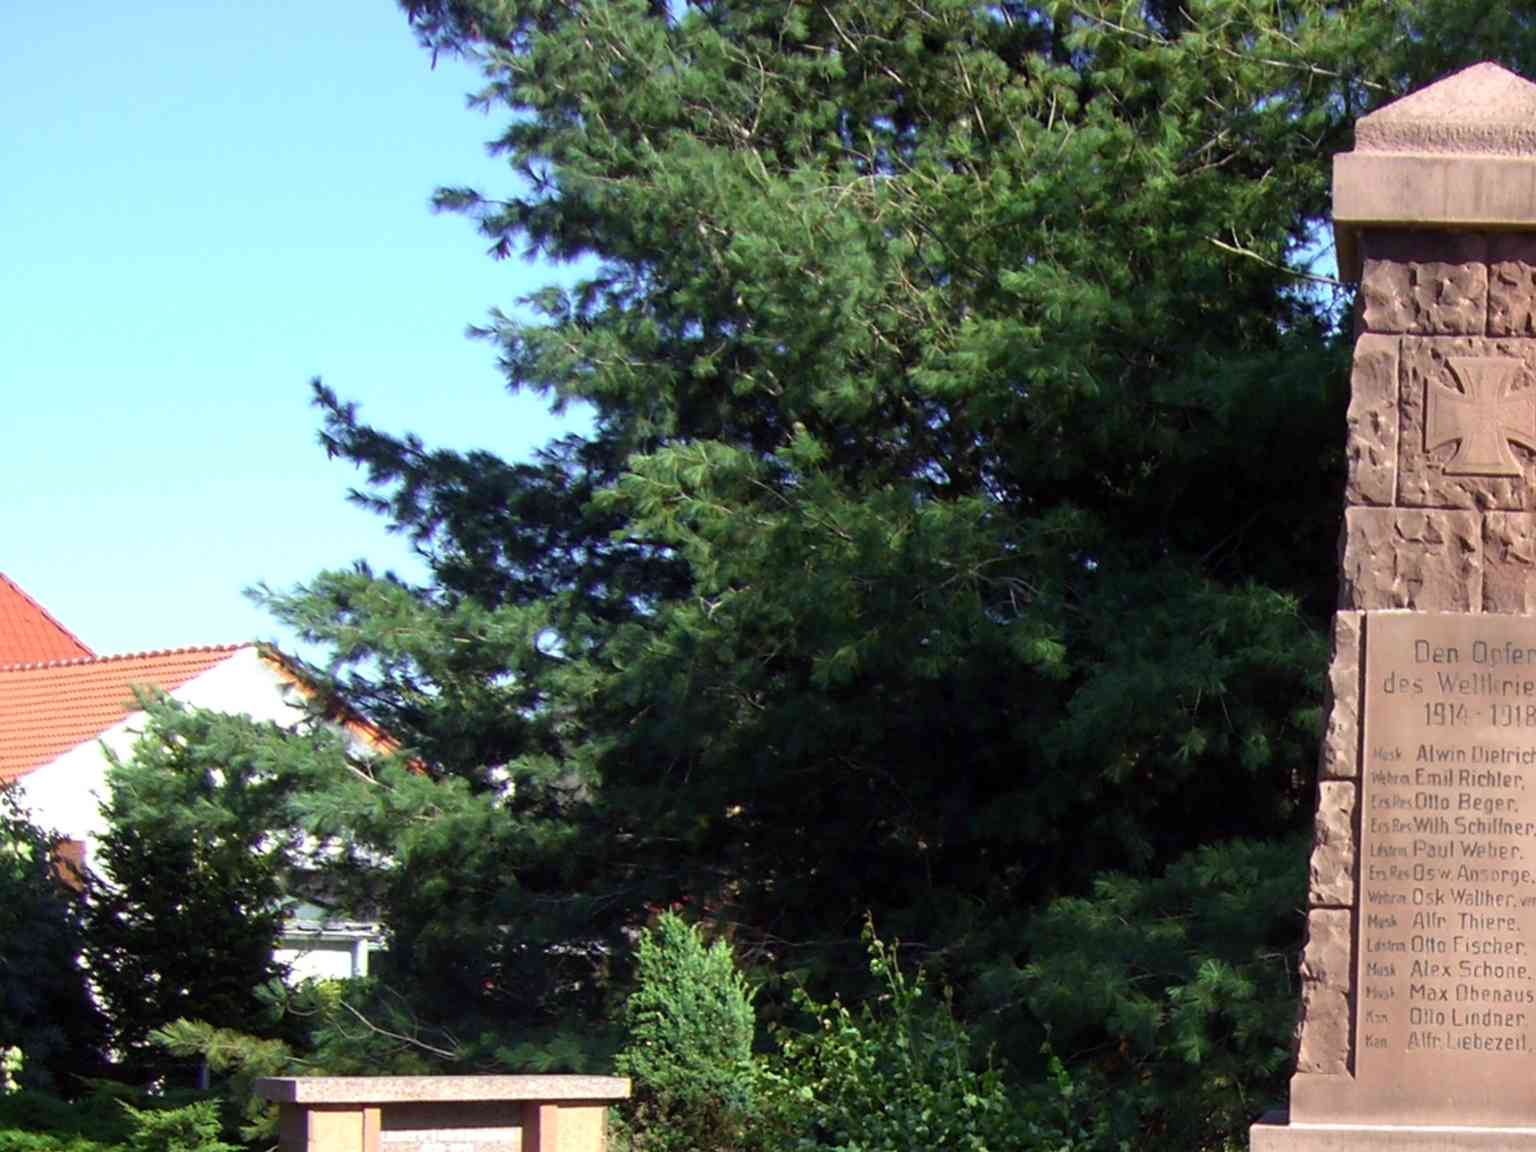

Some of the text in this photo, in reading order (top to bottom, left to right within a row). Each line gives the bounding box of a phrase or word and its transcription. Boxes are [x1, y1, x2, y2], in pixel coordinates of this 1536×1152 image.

[1414, 639, 1459, 665] Den
[1383, 672, 1424, 695] des
[1416, 744, 1466, 763] Alwin
[1415, 768, 1454, 787] Emil
[1415, 792, 1450, 811] Otto
[1412, 840, 1455, 858] Paul
[1411, 935, 1447, 953] Otto
[1410, 960, 1452, 978] Alex
[1409, 984, 1449, 1001] Max
[1409, 1008, 1446, 1027] Otto
